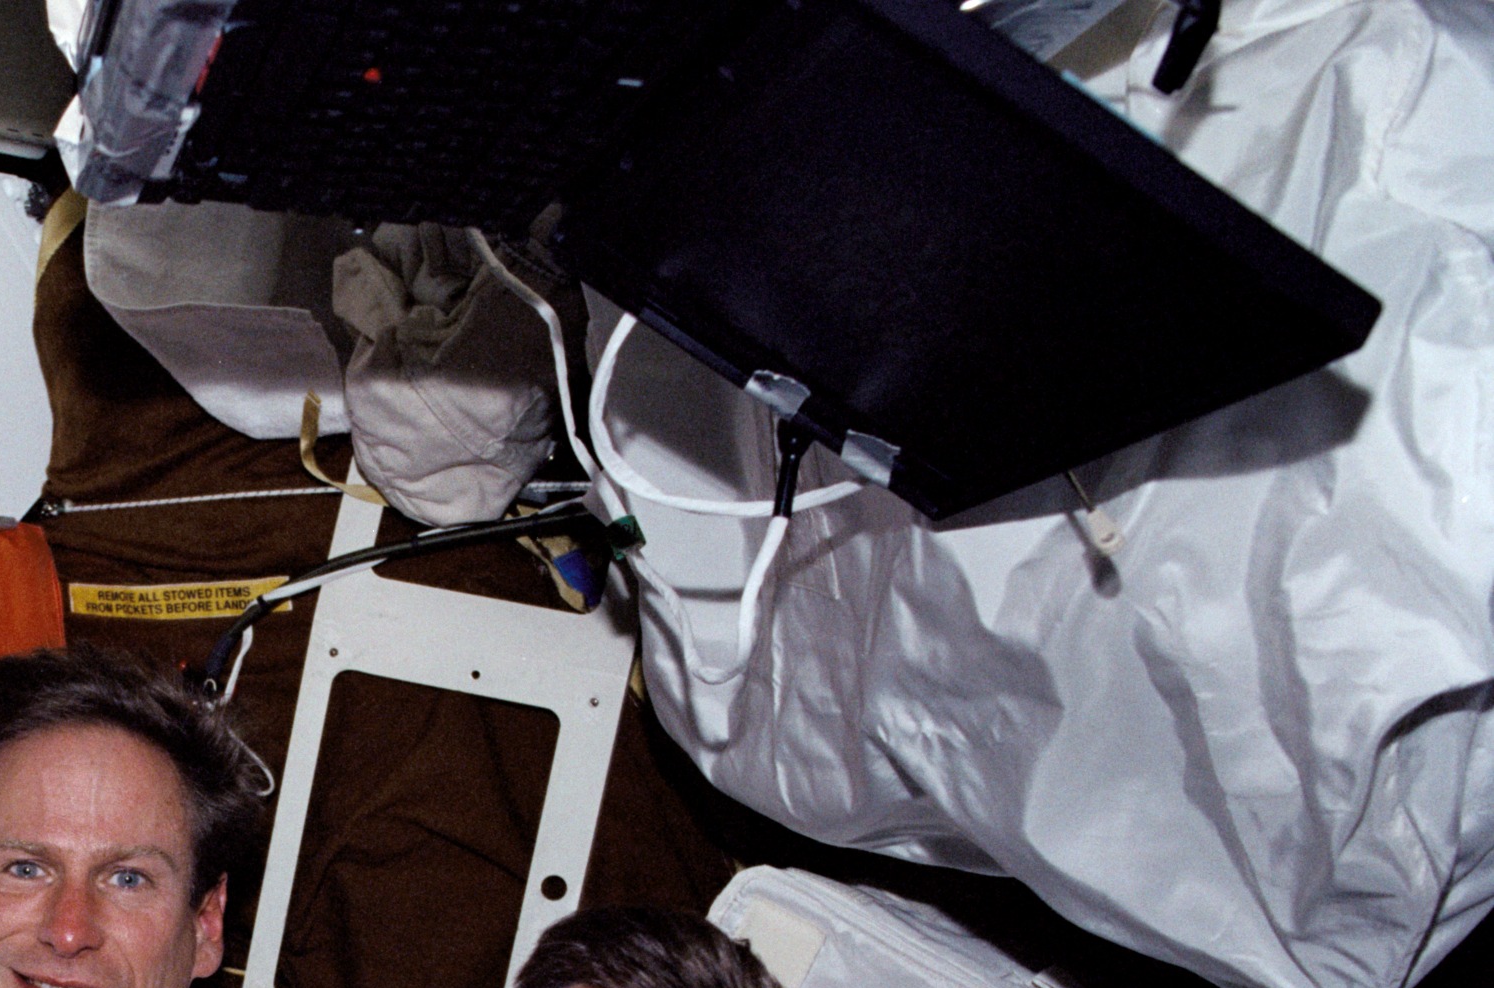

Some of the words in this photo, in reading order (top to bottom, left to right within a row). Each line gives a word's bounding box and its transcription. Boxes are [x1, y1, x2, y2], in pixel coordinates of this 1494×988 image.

[138, 591, 159, 602] ALL
[163, 589, 213, 601] STOWED
[215, 587, 250, 598] ITEMS
[86, 602, 113, 613] FROM
[166, 602, 212, 614] BEFORE
[216, 600, 249, 611] LAND
